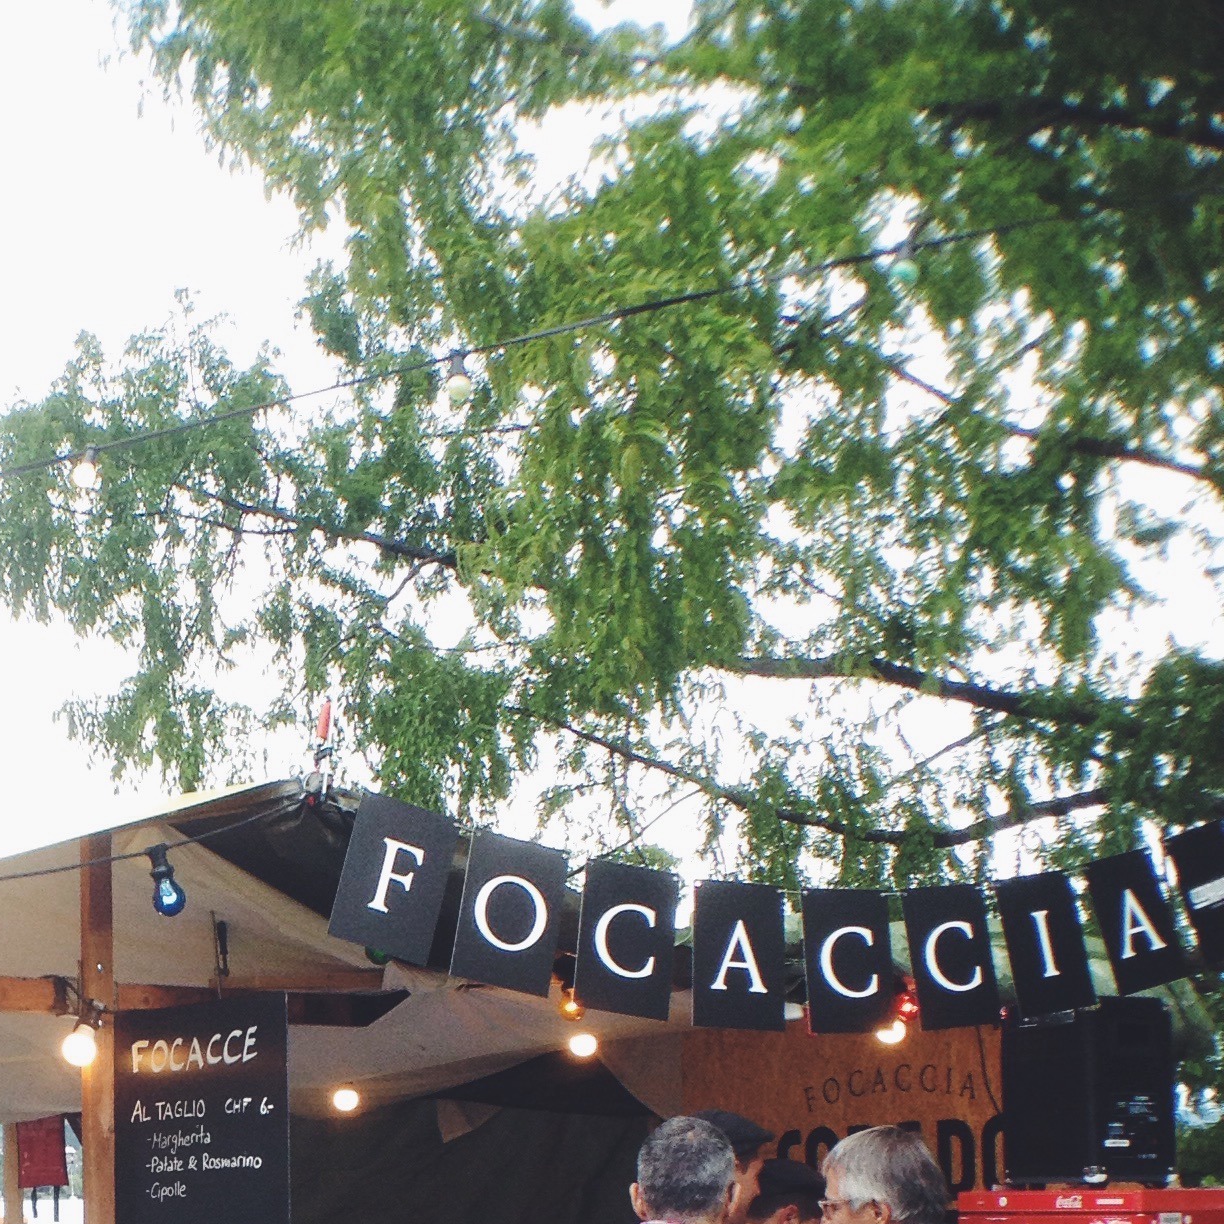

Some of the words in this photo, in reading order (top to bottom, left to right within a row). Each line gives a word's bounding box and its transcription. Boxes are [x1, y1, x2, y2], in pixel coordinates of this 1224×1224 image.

[366, 836, 1168, 998] FOCACCIA
[131, 1025, 258, 1074] FOCACCE
[155, 1099, 206, 1121] TAGLIO
[225, 1097, 252, 1114] CHF
[803, 1063, 976, 1113] FOCACCIA
[188, 1156, 198, 1171] &
[202, 1152, 263, 1172] Rosmarino
